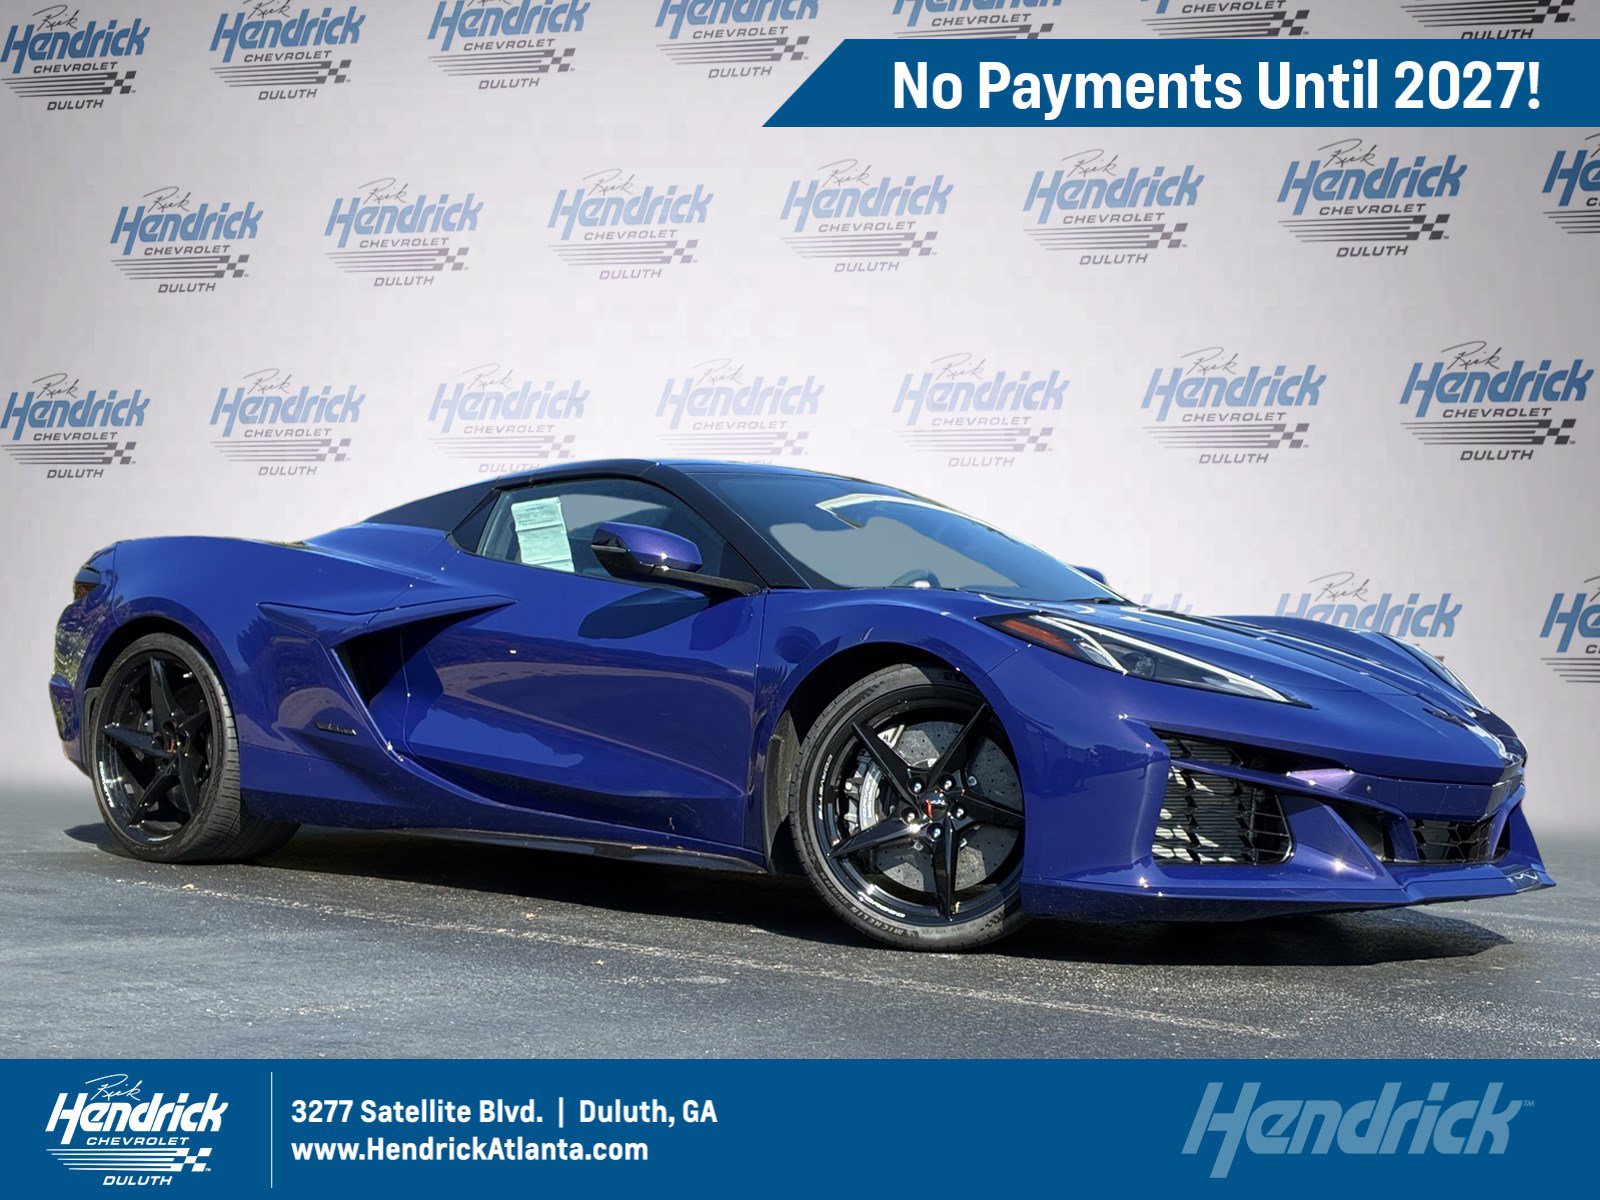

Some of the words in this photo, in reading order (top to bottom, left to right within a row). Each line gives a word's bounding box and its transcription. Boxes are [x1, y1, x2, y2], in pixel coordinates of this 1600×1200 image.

[1181, 0, 1287, 14] CHEVROLET
[427, 0, 591, 51] Hendrick
[931, 13, 1032, 27] CHEVROLET
[209, 5, 366, 63] Hendrick
[692, 26, 789, 40] CHEVROLET
[0, 18, 150, 74] Hendrick
[463, 38, 556, 51] CHEVROLET
[244, 50, 332, 63] CHEVROLET
[33, 61, 117, 74] CHEVROLET
[707, 65, 772, 79] DULUTH
[478, 77, 540, 90] DULUTH
[258, 88, 317, 101] DULUTH
[47, 98, 103, 111] DULUTH
[1276, 155, 1469, 216] Hendrick
[1022, 164, 1205, 224] Hendrick
[779, 175, 955, 233] Hendrick
[1319, 203, 1426, 216] CHEVROLET
[547, 184, 714, 241] Hendrick
[1062, 212, 1165, 225] CHEVROLET
[323, 193, 485, 249] Hendrick
[818, 221, 917, 233] CHEVROLET
[110, 202, 264, 256] Hendrick
[583, 229, 678, 241] CHEVROLET
[359, 237, 449, 249] CHEVROLET
[143, 245, 231, 256] CHEVROLET
[1336, 245, 1408, 258] DULUTH
[1079, 253, 1148, 266] DULUTH
[834, 261, 900, 273] DULUTH
[373, 275, 435, 287] DULUTH
[598, 268, 663, 281] DULUTH
[158, 281, 216, 293] DULUTH
[1141, 364, 1327, 422] Hendrick
[1399, 359, 1595, 418] Hendrick
[655, 375, 826, 429] Hendrick
[893, 370, 1071, 426] Hendrick
[209, 384, 366, 437] Hendrick
[427, 380, 591, 434] Hendrick
[1442, 407, 1552, 418] CHEVROLET
[0, 389, 150, 441] Hendrick
[931, 415, 1032, 427] CHEVROLET
[1181, 411, 1287, 423] CHEVROLET
[463, 423, 556, 434] CHEVROLET
[692, 420, 789, 430] CHEVROLET
[33, 430, 117, 441] CHEVROLET
[244, 427, 332, 438] CHEVROLET
[948, 455, 1015, 468] DULUTH
[1199, 452, 1269, 464] DULUTH
[1459, 449, 1535, 461] DULUTH
[47, 467, 103, 479] DULUTH
[258, 464, 318, 476] DULUTH
[850, 906, 904, 936] MICHELIN
